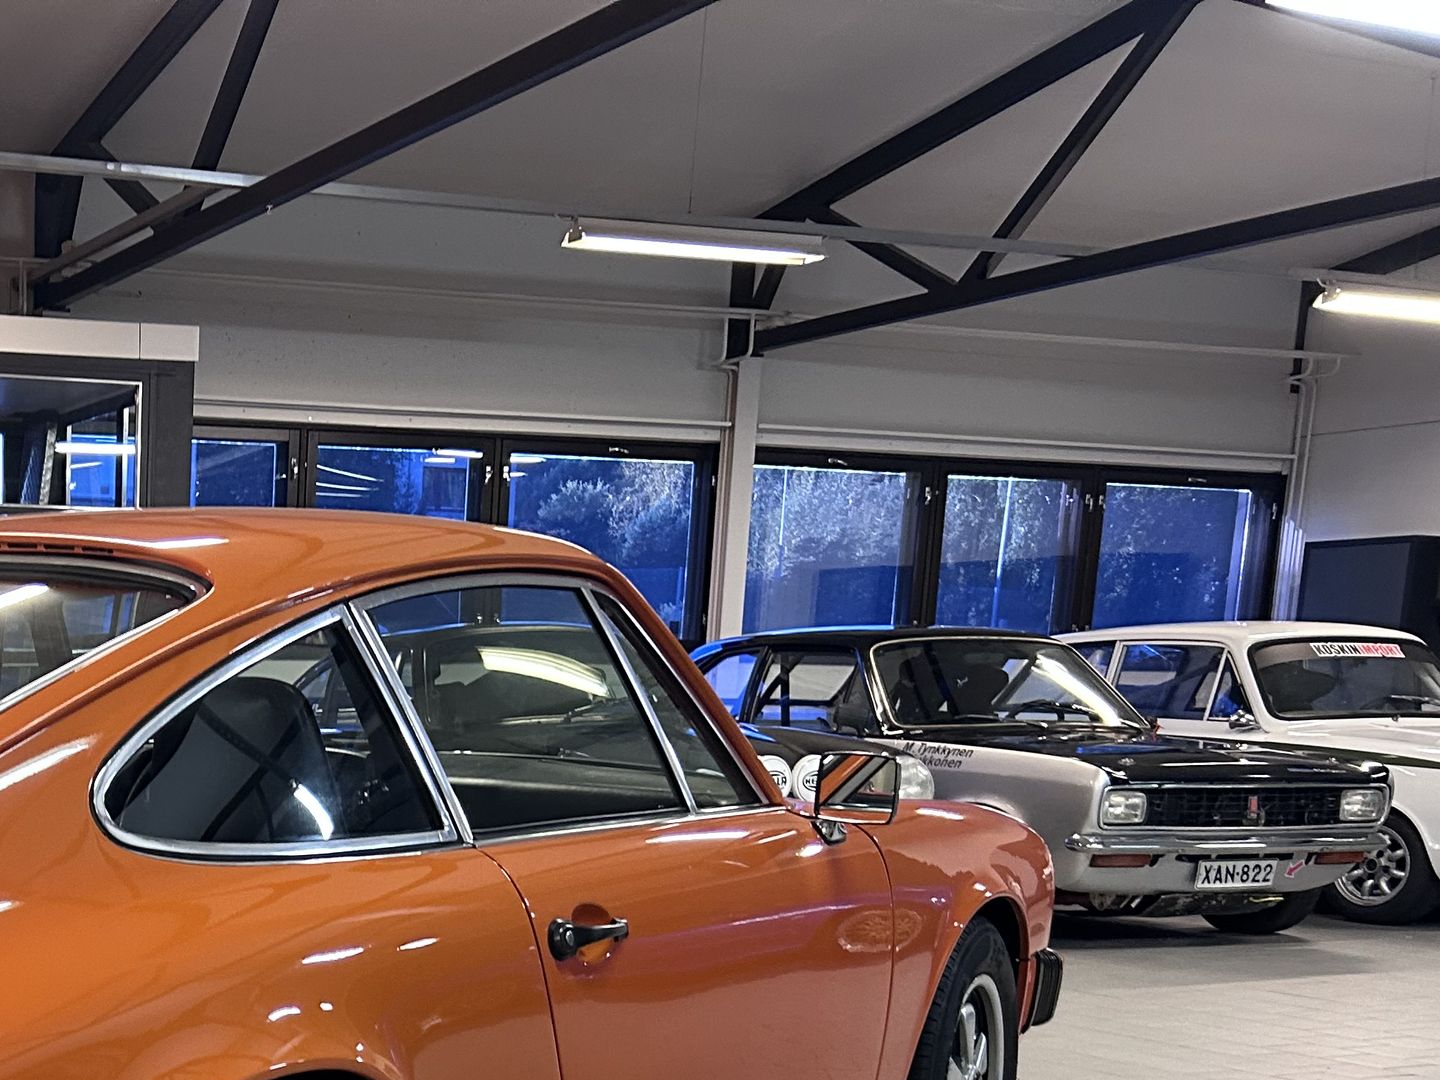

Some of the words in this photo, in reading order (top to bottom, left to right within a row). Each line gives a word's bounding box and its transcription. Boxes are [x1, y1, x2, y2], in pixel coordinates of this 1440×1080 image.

[1312, 643, 1403, 656] KOSKINIMPORT
[903, 742, 915, 753] M.
[917, 743, 974, 758] Tynkkynen
[919, 756, 962, 768] kkonen
[1201, 863, 1273, 884] XAN-822
